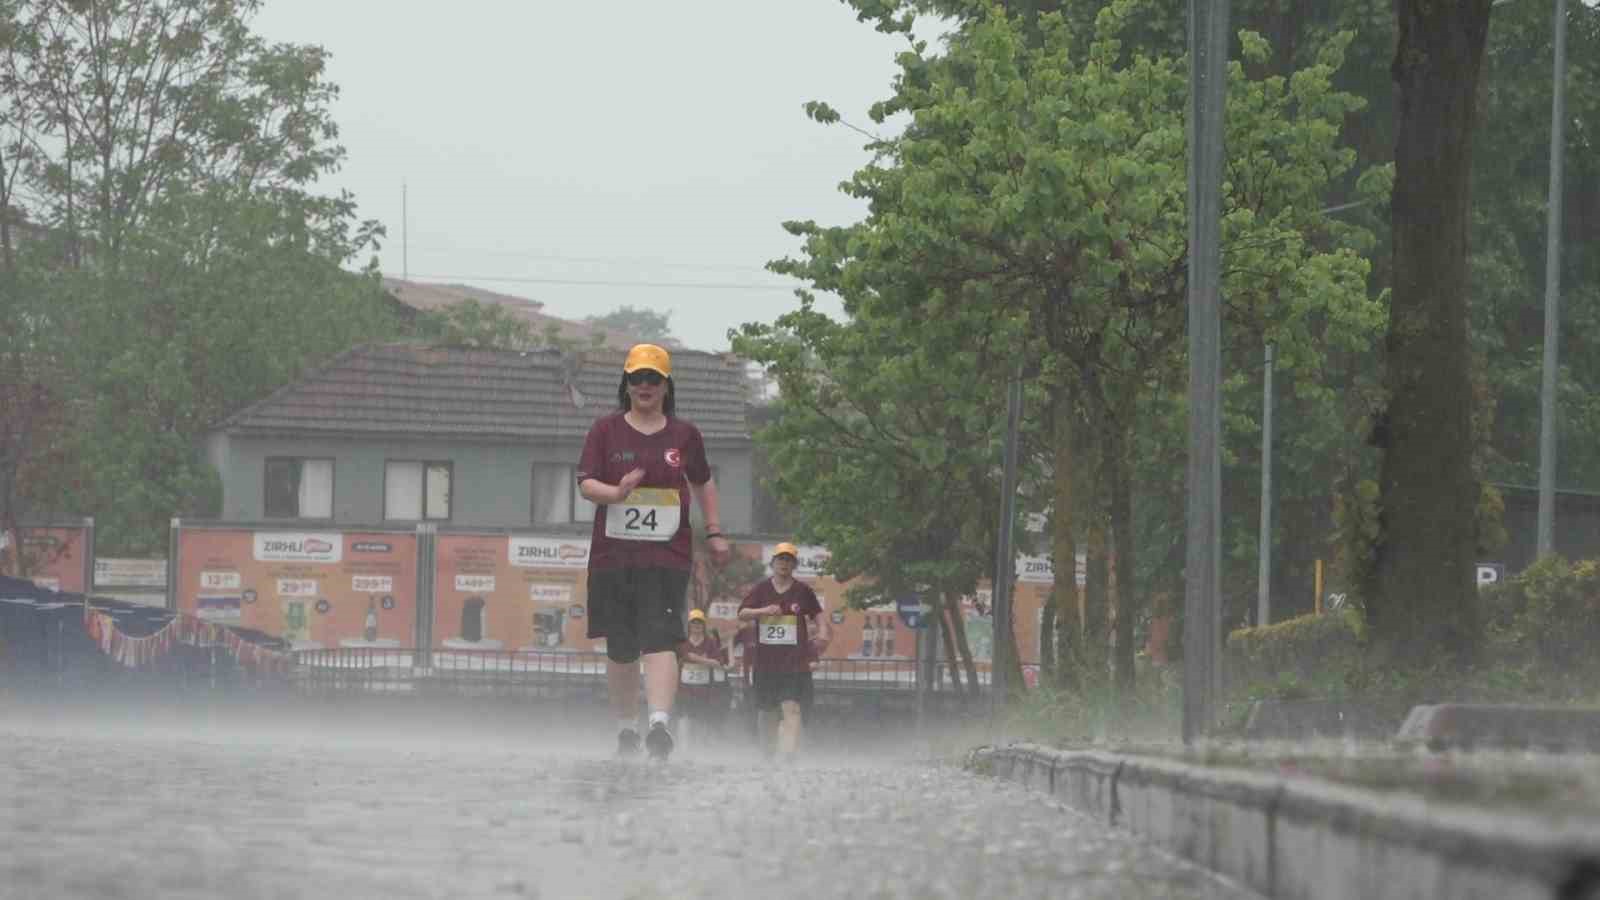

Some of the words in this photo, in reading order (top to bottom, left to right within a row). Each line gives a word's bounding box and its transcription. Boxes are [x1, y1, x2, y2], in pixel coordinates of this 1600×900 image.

[625, 507, 658, 531] 24
[1476, 566, 1498, 588] P
[767, 626, 785, 639] 29
